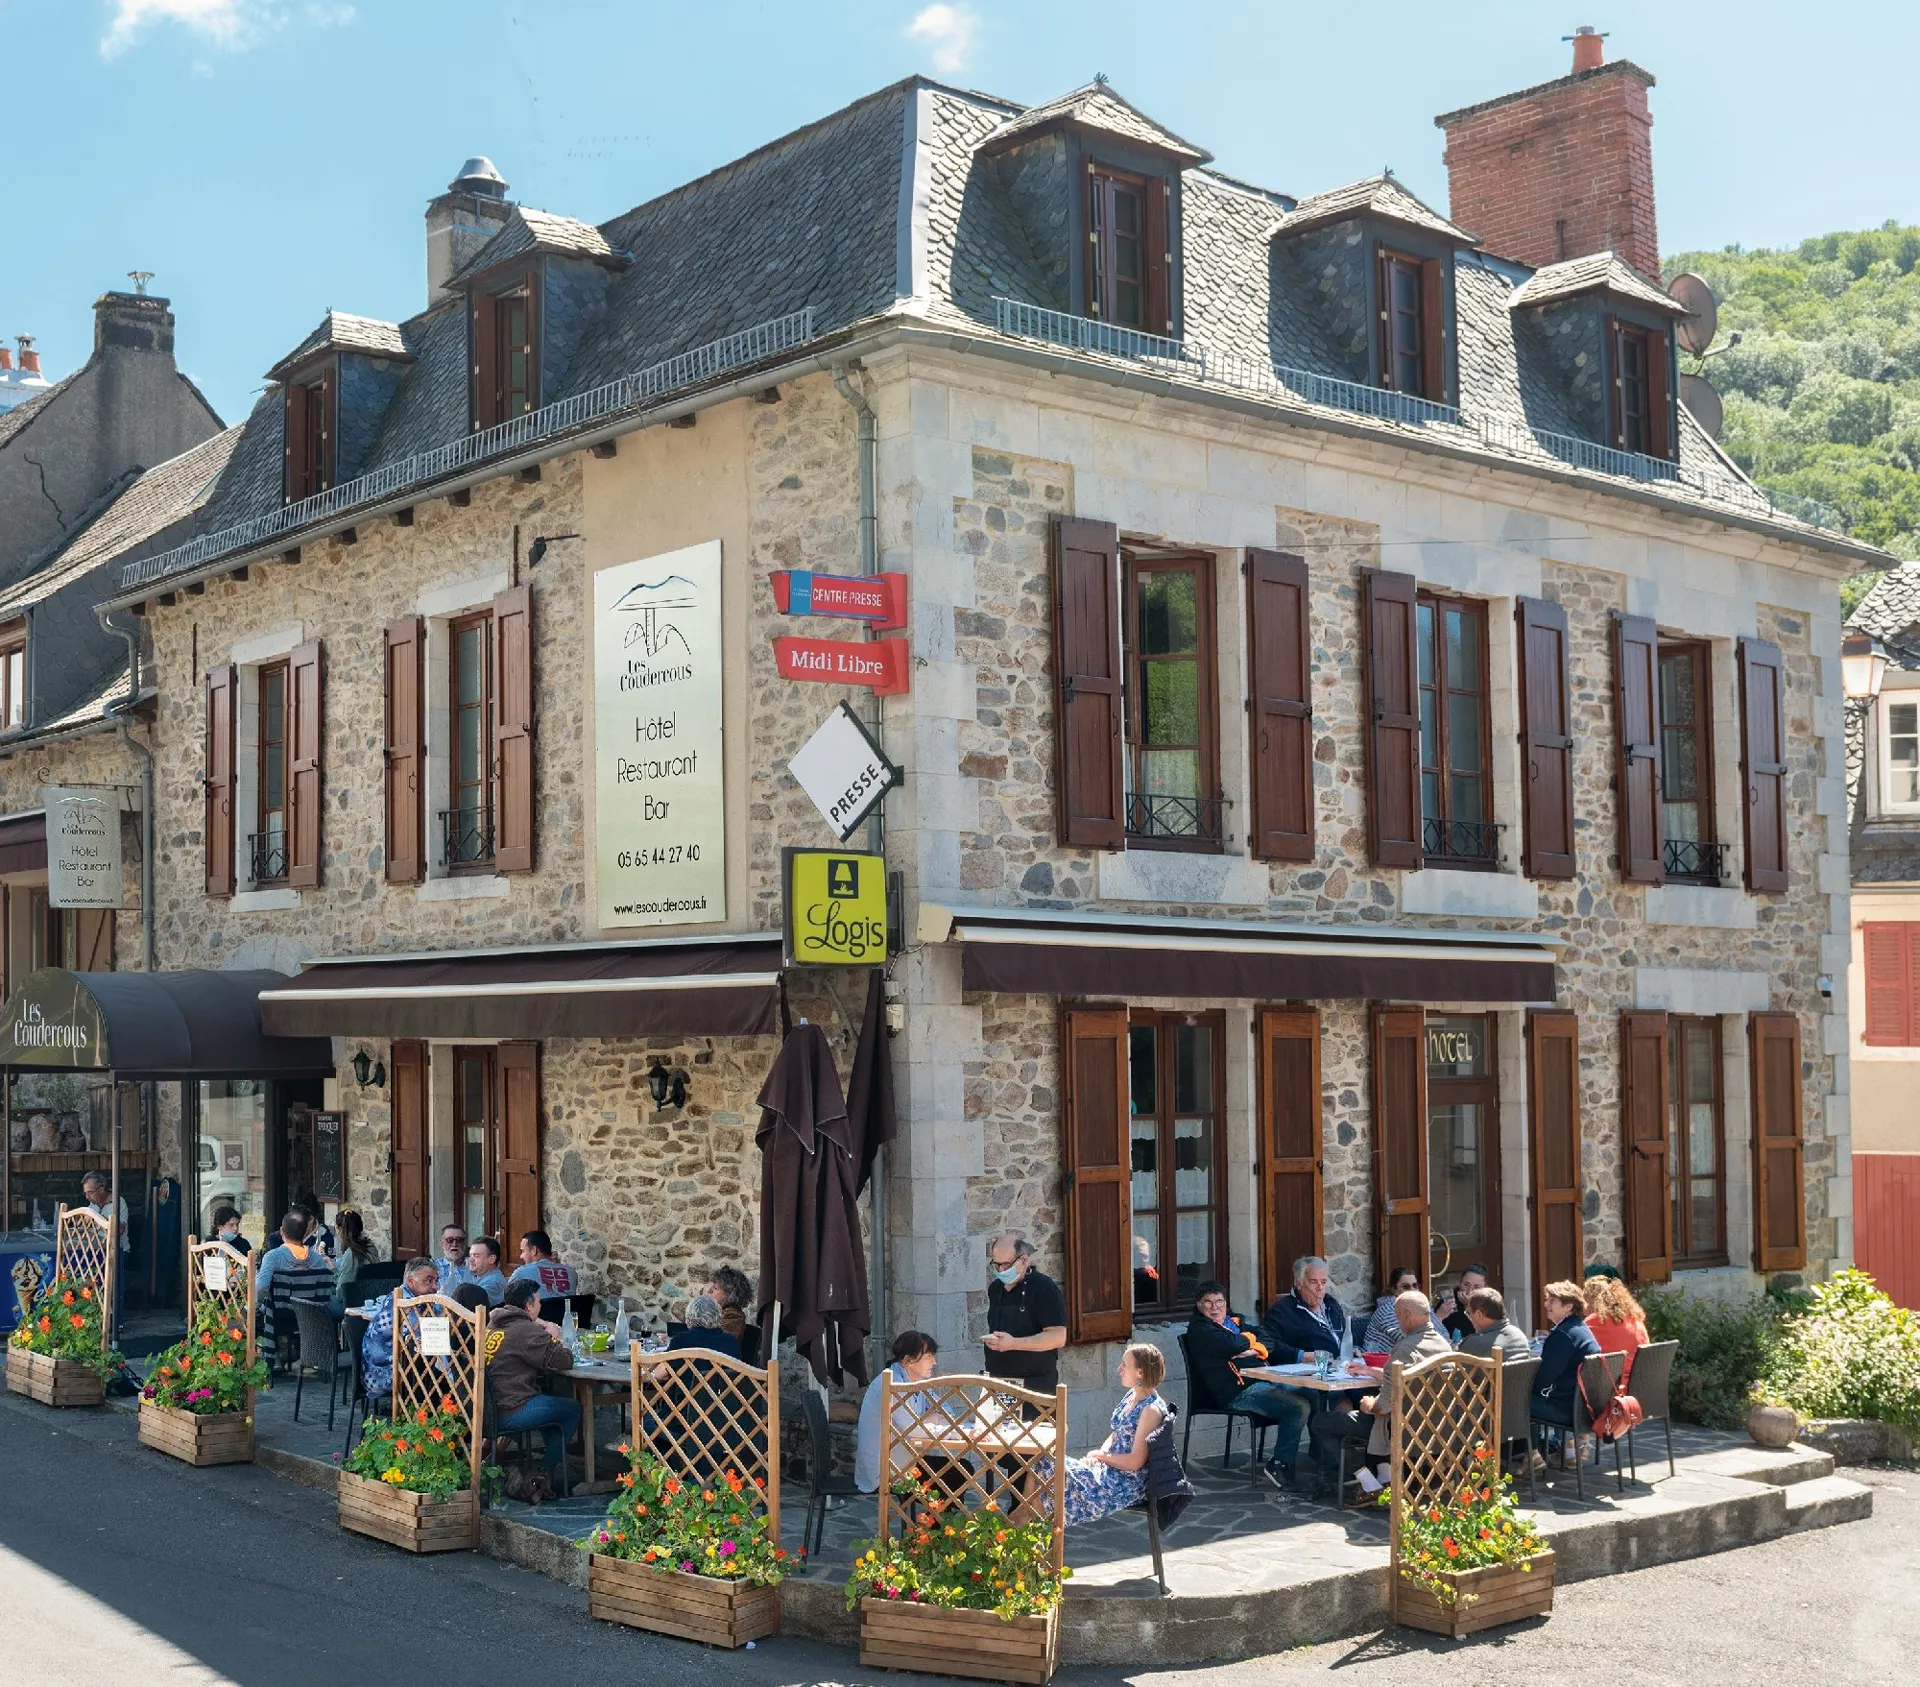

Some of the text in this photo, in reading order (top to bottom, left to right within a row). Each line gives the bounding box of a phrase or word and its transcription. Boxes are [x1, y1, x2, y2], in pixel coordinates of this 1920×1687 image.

[812, 588, 882, 607] CENTRE PRESSE
[628, 660, 646, 675] Les
[791, 650, 884, 675] Midi Libre
[620, 664, 692, 692] Coudercous
[635, 711, 676, 742] Hôtel
[617, 749, 698, 784] Restaurant
[829, 764, 879, 823] PRESSE
[644, 795, 670, 821] Bar
[71, 845, 98, 857] Hôtel
[617, 844, 701, 868] 05 65 44 27 40
[59, 860, 111, 871] Restaurant
[77, 875, 95, 887] Bar
[614, 895, 707, 915] www.lescoudercous.fr
[803, 900, 884, 957] Logis
[23, 999, 41, 1023] Les
[14, 1017, 87, 1048] Coudercous
